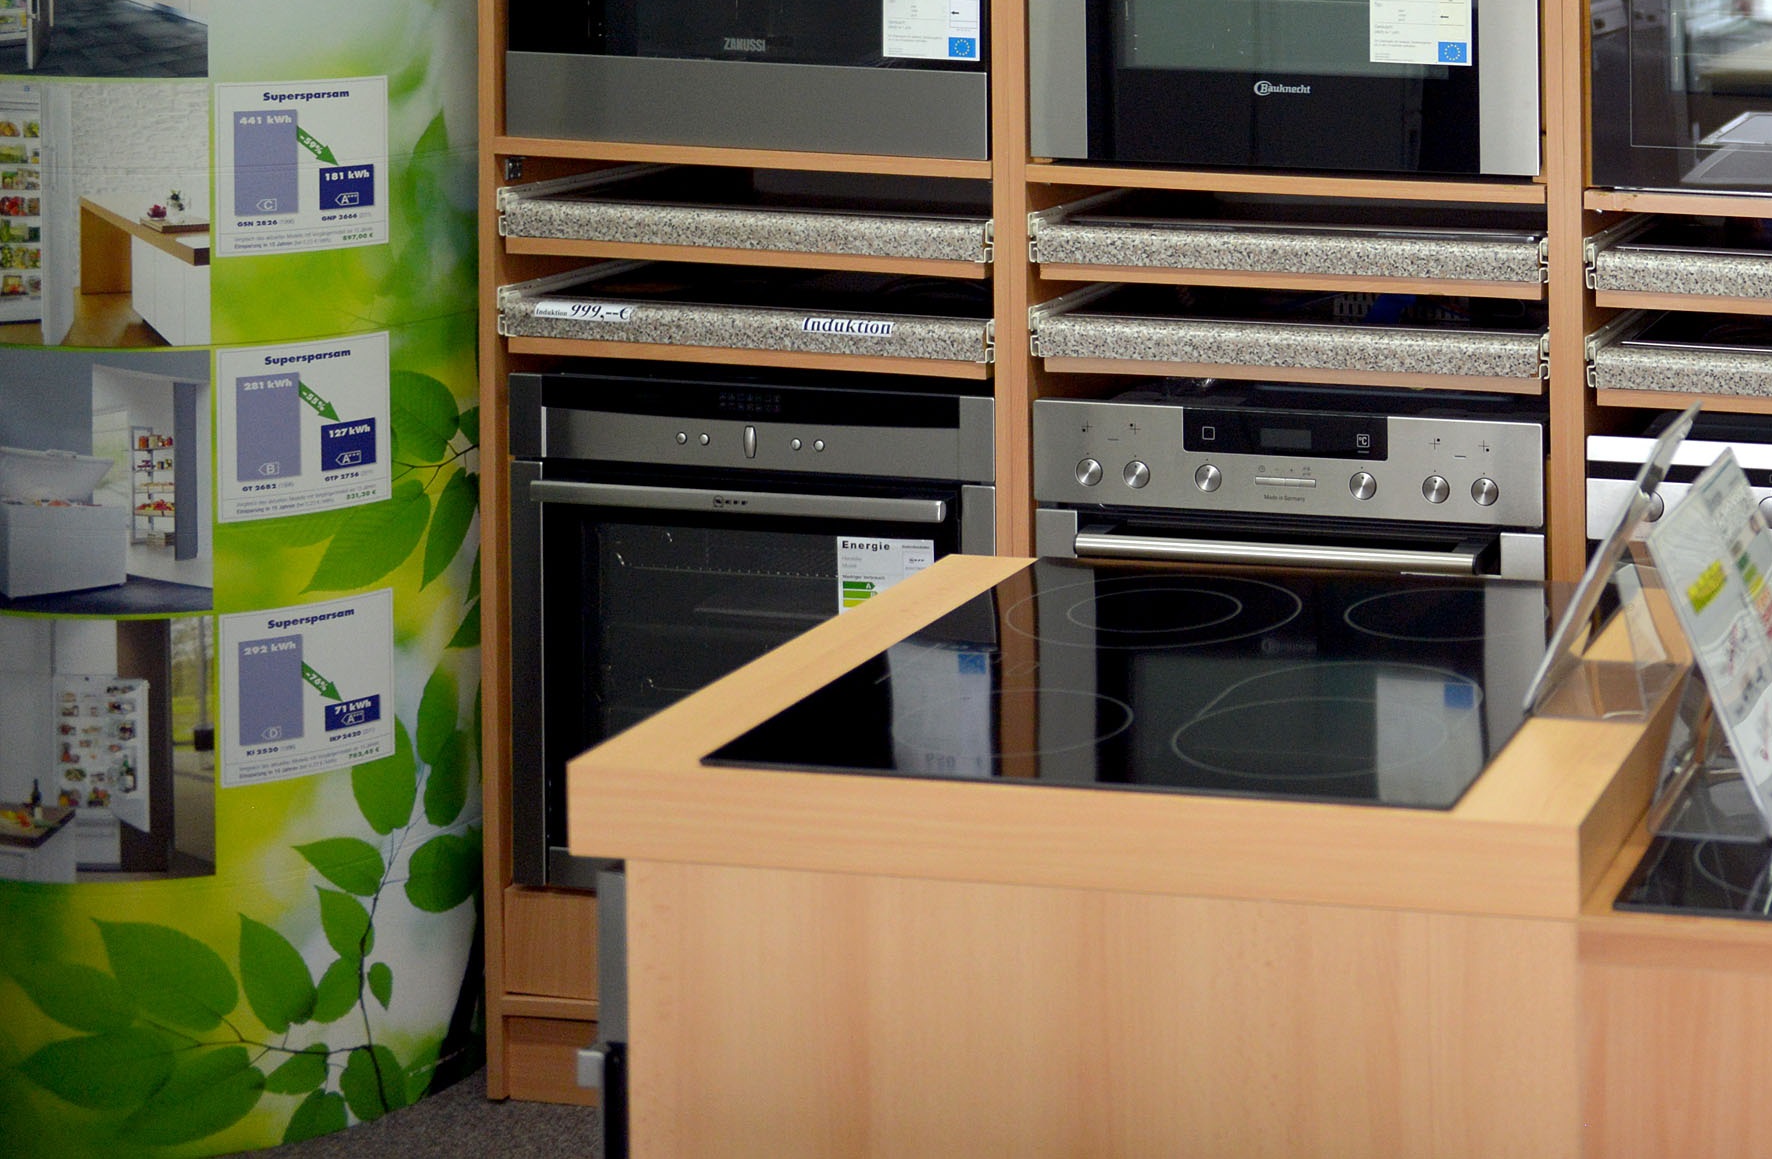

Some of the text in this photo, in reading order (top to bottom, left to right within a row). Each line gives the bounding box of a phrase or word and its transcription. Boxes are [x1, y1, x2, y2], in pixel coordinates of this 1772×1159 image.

[724, 38, 766, 52] ZANUSSI
[263, 90, 349, 102] Supersparsam
[1256, 82, 1311, 96] Bauknecht
[240, 115, 292, 124] 441 kWh
[325, 170, 370, 181] 181 kWh
[570, 304, 632, 321] 999,--€
[803, 318, 891, 334] Induktion
[264, 350, 350, 366] Supersparsam
[244, 378, 292, 390] 281 kWh
[328, 424, 371, 438] 127 kWh
[842, 540, 890, 551] Energie
[268, 608, 354, 629] Supersparsam
[244, 642, 296, 656] 292 kWh
[334, 702, 372, 715] 71 kWh
